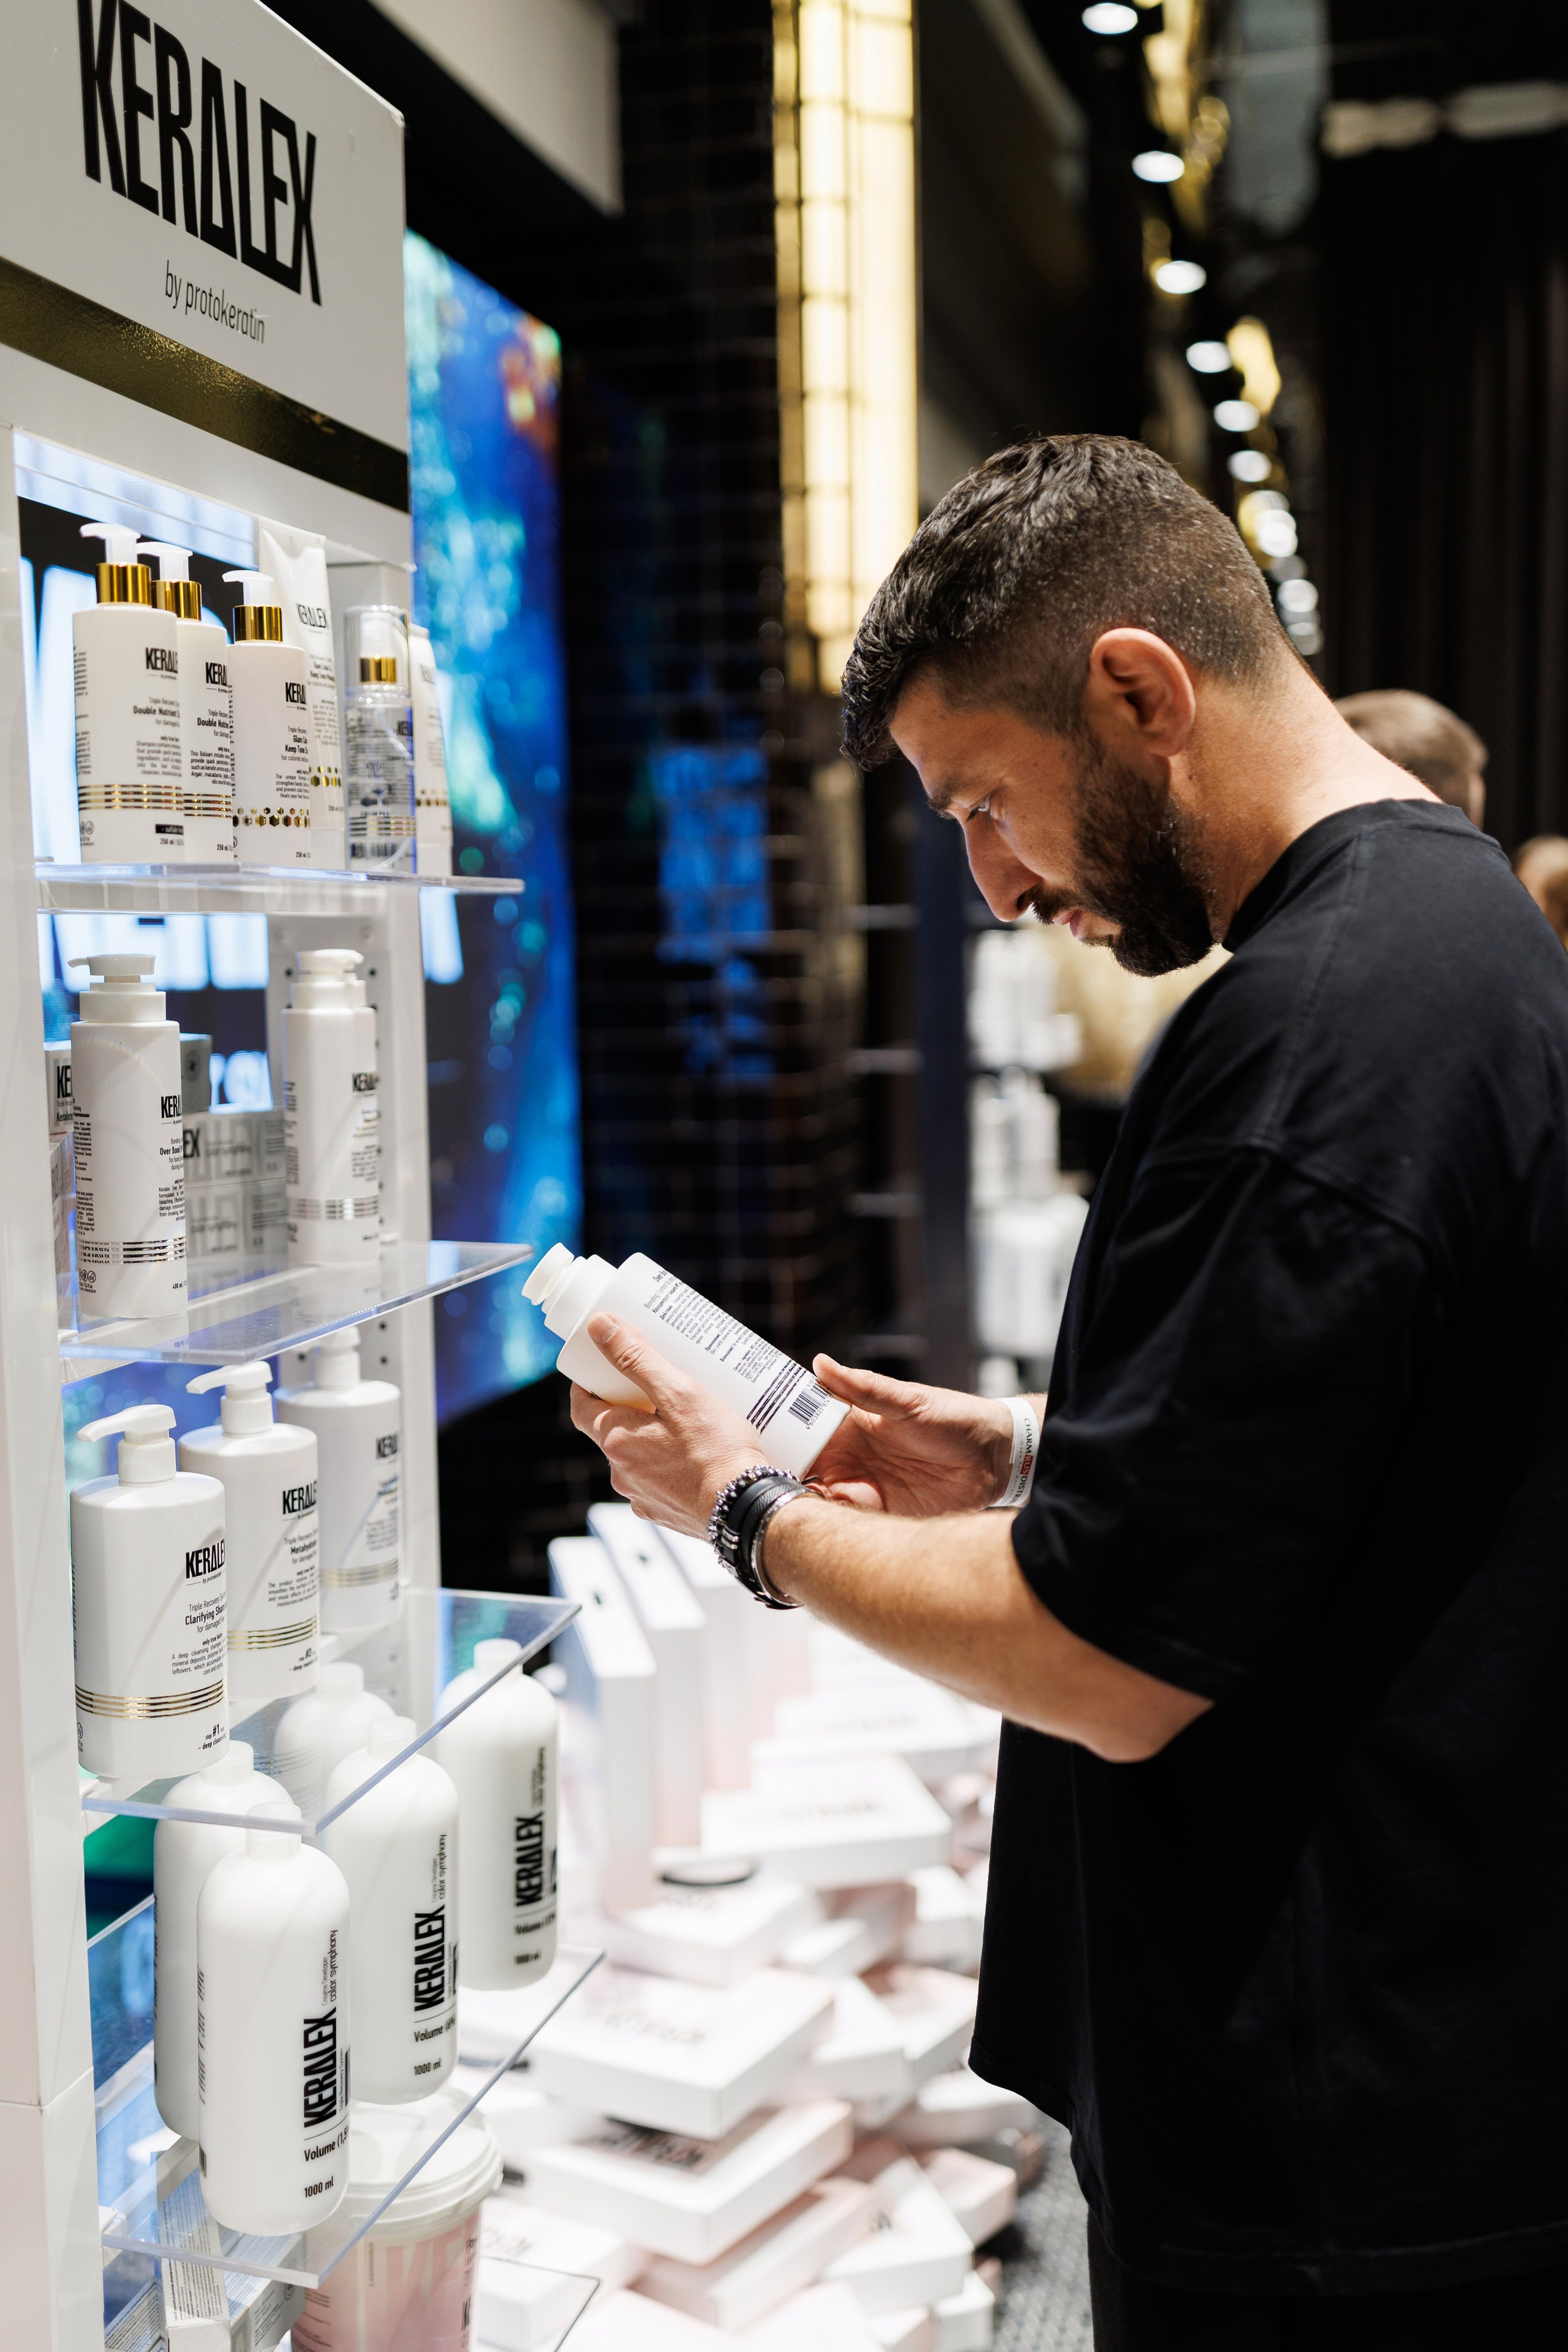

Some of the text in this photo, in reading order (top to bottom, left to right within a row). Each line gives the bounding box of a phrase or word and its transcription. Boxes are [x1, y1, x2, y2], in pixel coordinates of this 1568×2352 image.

[77, 0, 322, 306] KERALEX
[165, 260, 265, 343] by protokeratin
[134, 705, 156, 715] Double
[197, 717, 217, 727] Double
[293, 735, 303, 744] Glam
[285, 744, 296, 755] Keep
[643, 1291, 660, 1310] Bonding
[1024, 1418, 1033, 1453] CHARM
[186, 1537, 225, 1579] KERALE
[189, 1597, 220, 1612] Triple Recovery
[185, 1610, 214, 1625] Clarifying
[172, 1649, 219, 1667] mineral deposits, polymer
[191, 1647, 209, 1657] cleansing
[172, 1666, 192, 1675] leftovers,
[213, 1724, 219, 1737] #1
[436, 1834, 447, 1899] color symphony
[327, 1929, 337, 2002] color symphony
[415, 1904, 445, 2012] KERALEX
[414, 2026, 443, 2042] Volume
[304, 2007, 337, 2128] KERALEX
[413, 2057, 442, 2075] 1000 ml
[304, 2141, 336, 2162] Volume
[304, 2176, 334, 2198] 1000 ml
